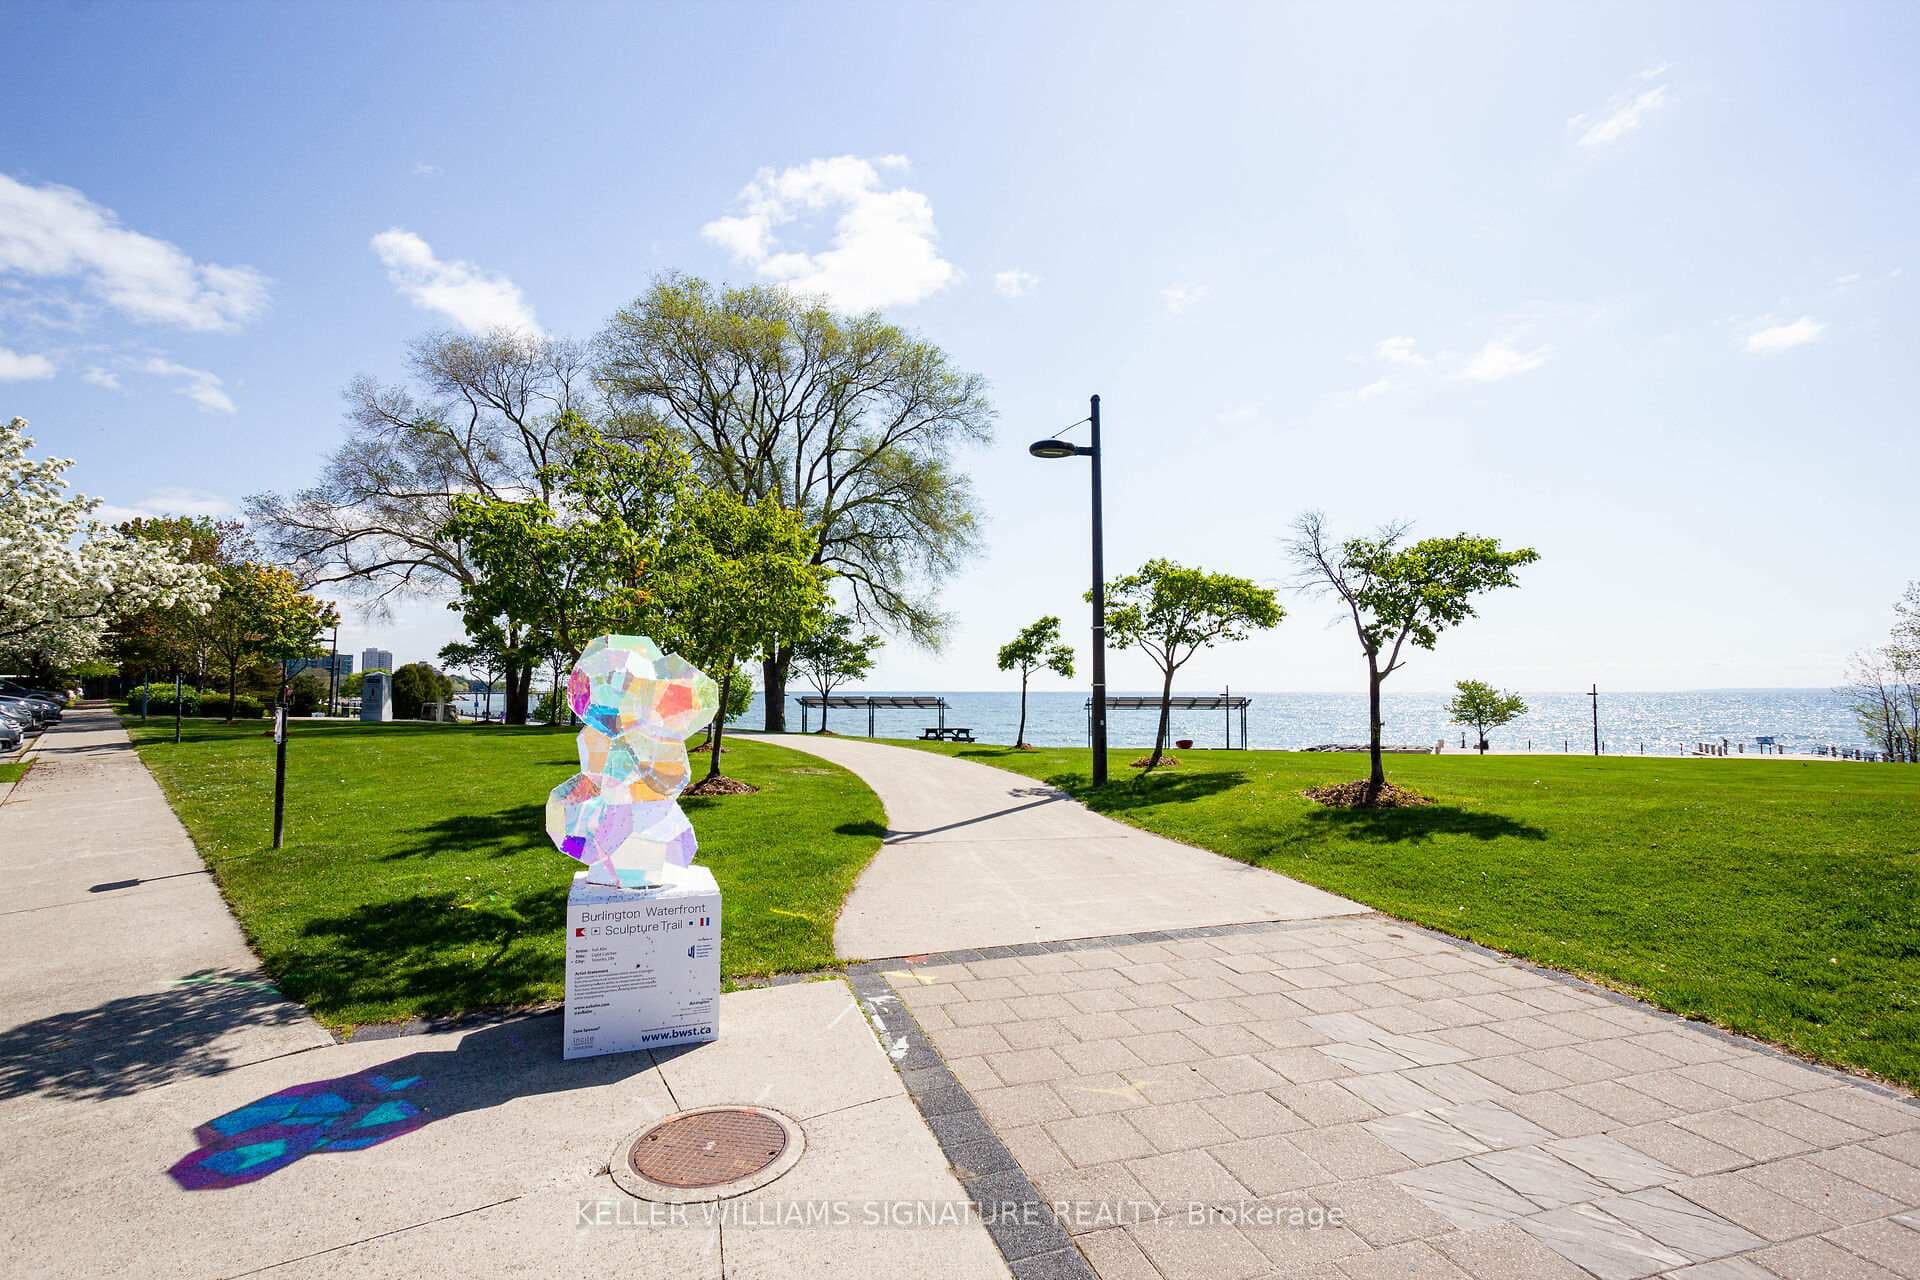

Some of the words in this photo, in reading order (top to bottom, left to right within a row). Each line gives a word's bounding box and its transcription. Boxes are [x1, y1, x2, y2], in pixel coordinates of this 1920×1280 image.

[581, 909, 641, 922] Burlington
[646, 904, 706, 917] Waterfront
[605, 922, 659, 936] Sculpture
[661, 919, 683, 931] Trail
[641, 1026, 711, 1042] www.bwst.ca
